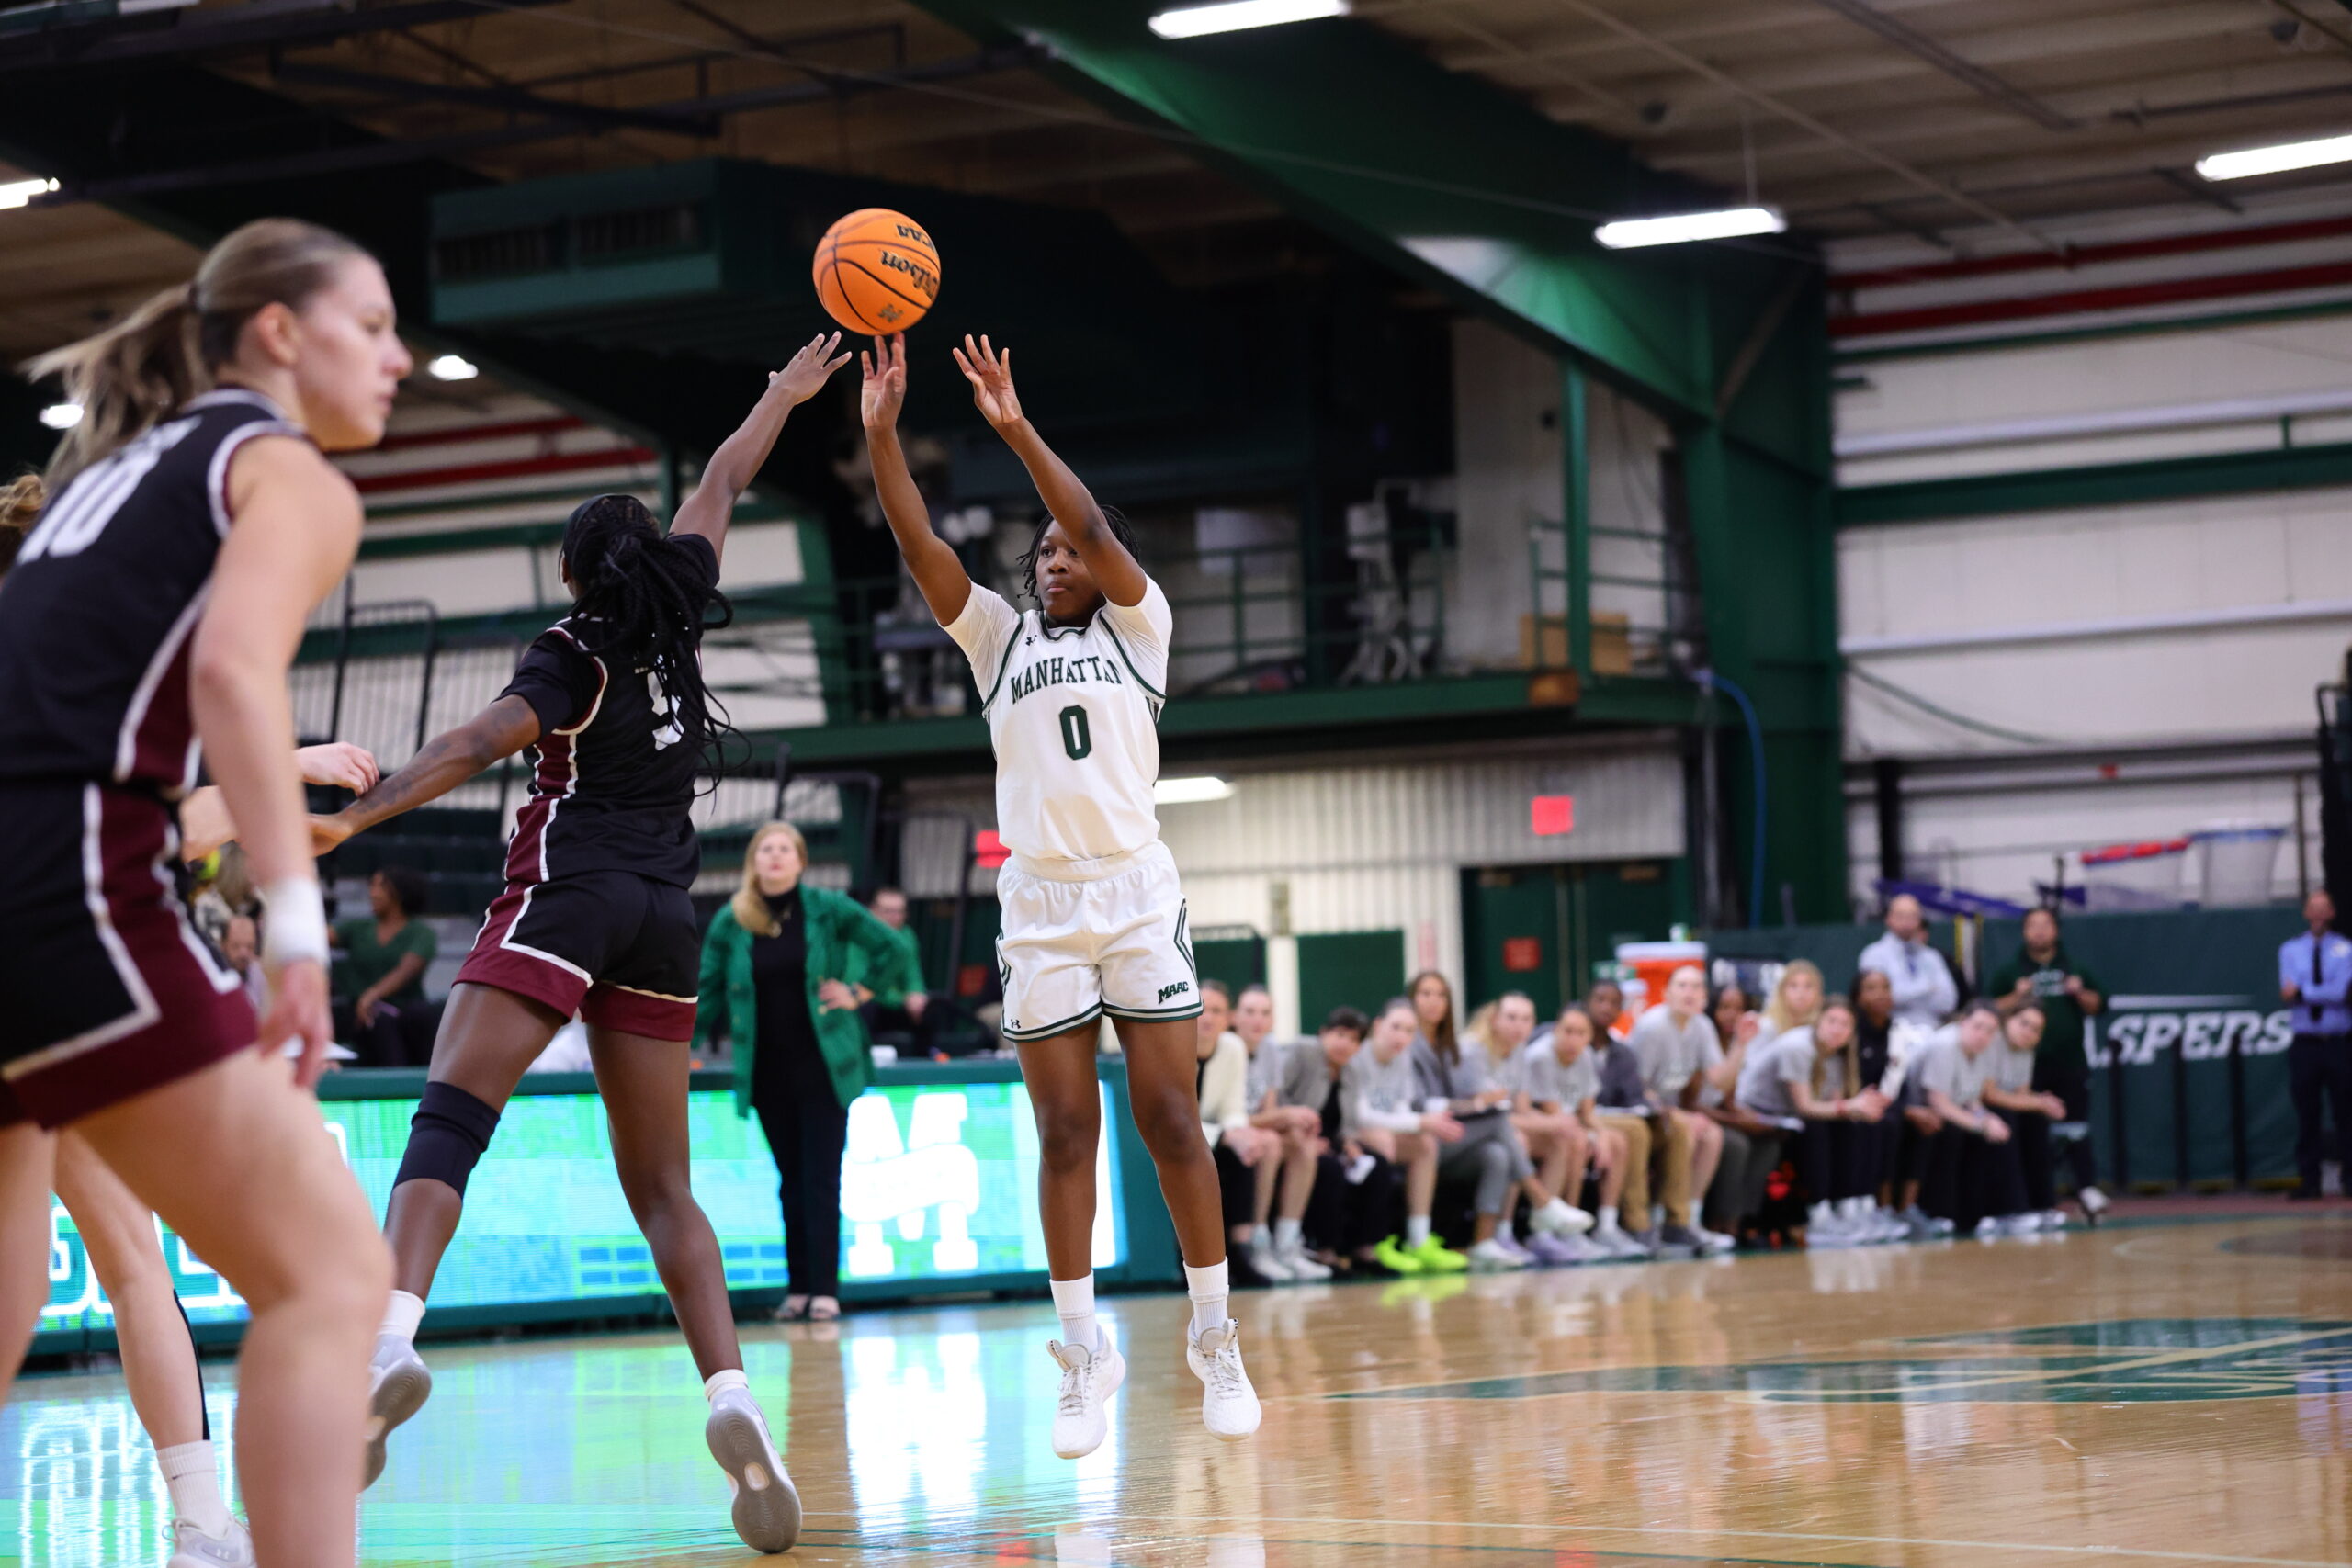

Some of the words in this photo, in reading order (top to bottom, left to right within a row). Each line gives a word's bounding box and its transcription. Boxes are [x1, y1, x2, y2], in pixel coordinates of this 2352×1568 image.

[17, 452, 162, 564] 10
[1059, 705, 1092, 761] 0
[1158, 981, 1189, 1005] MAAC
